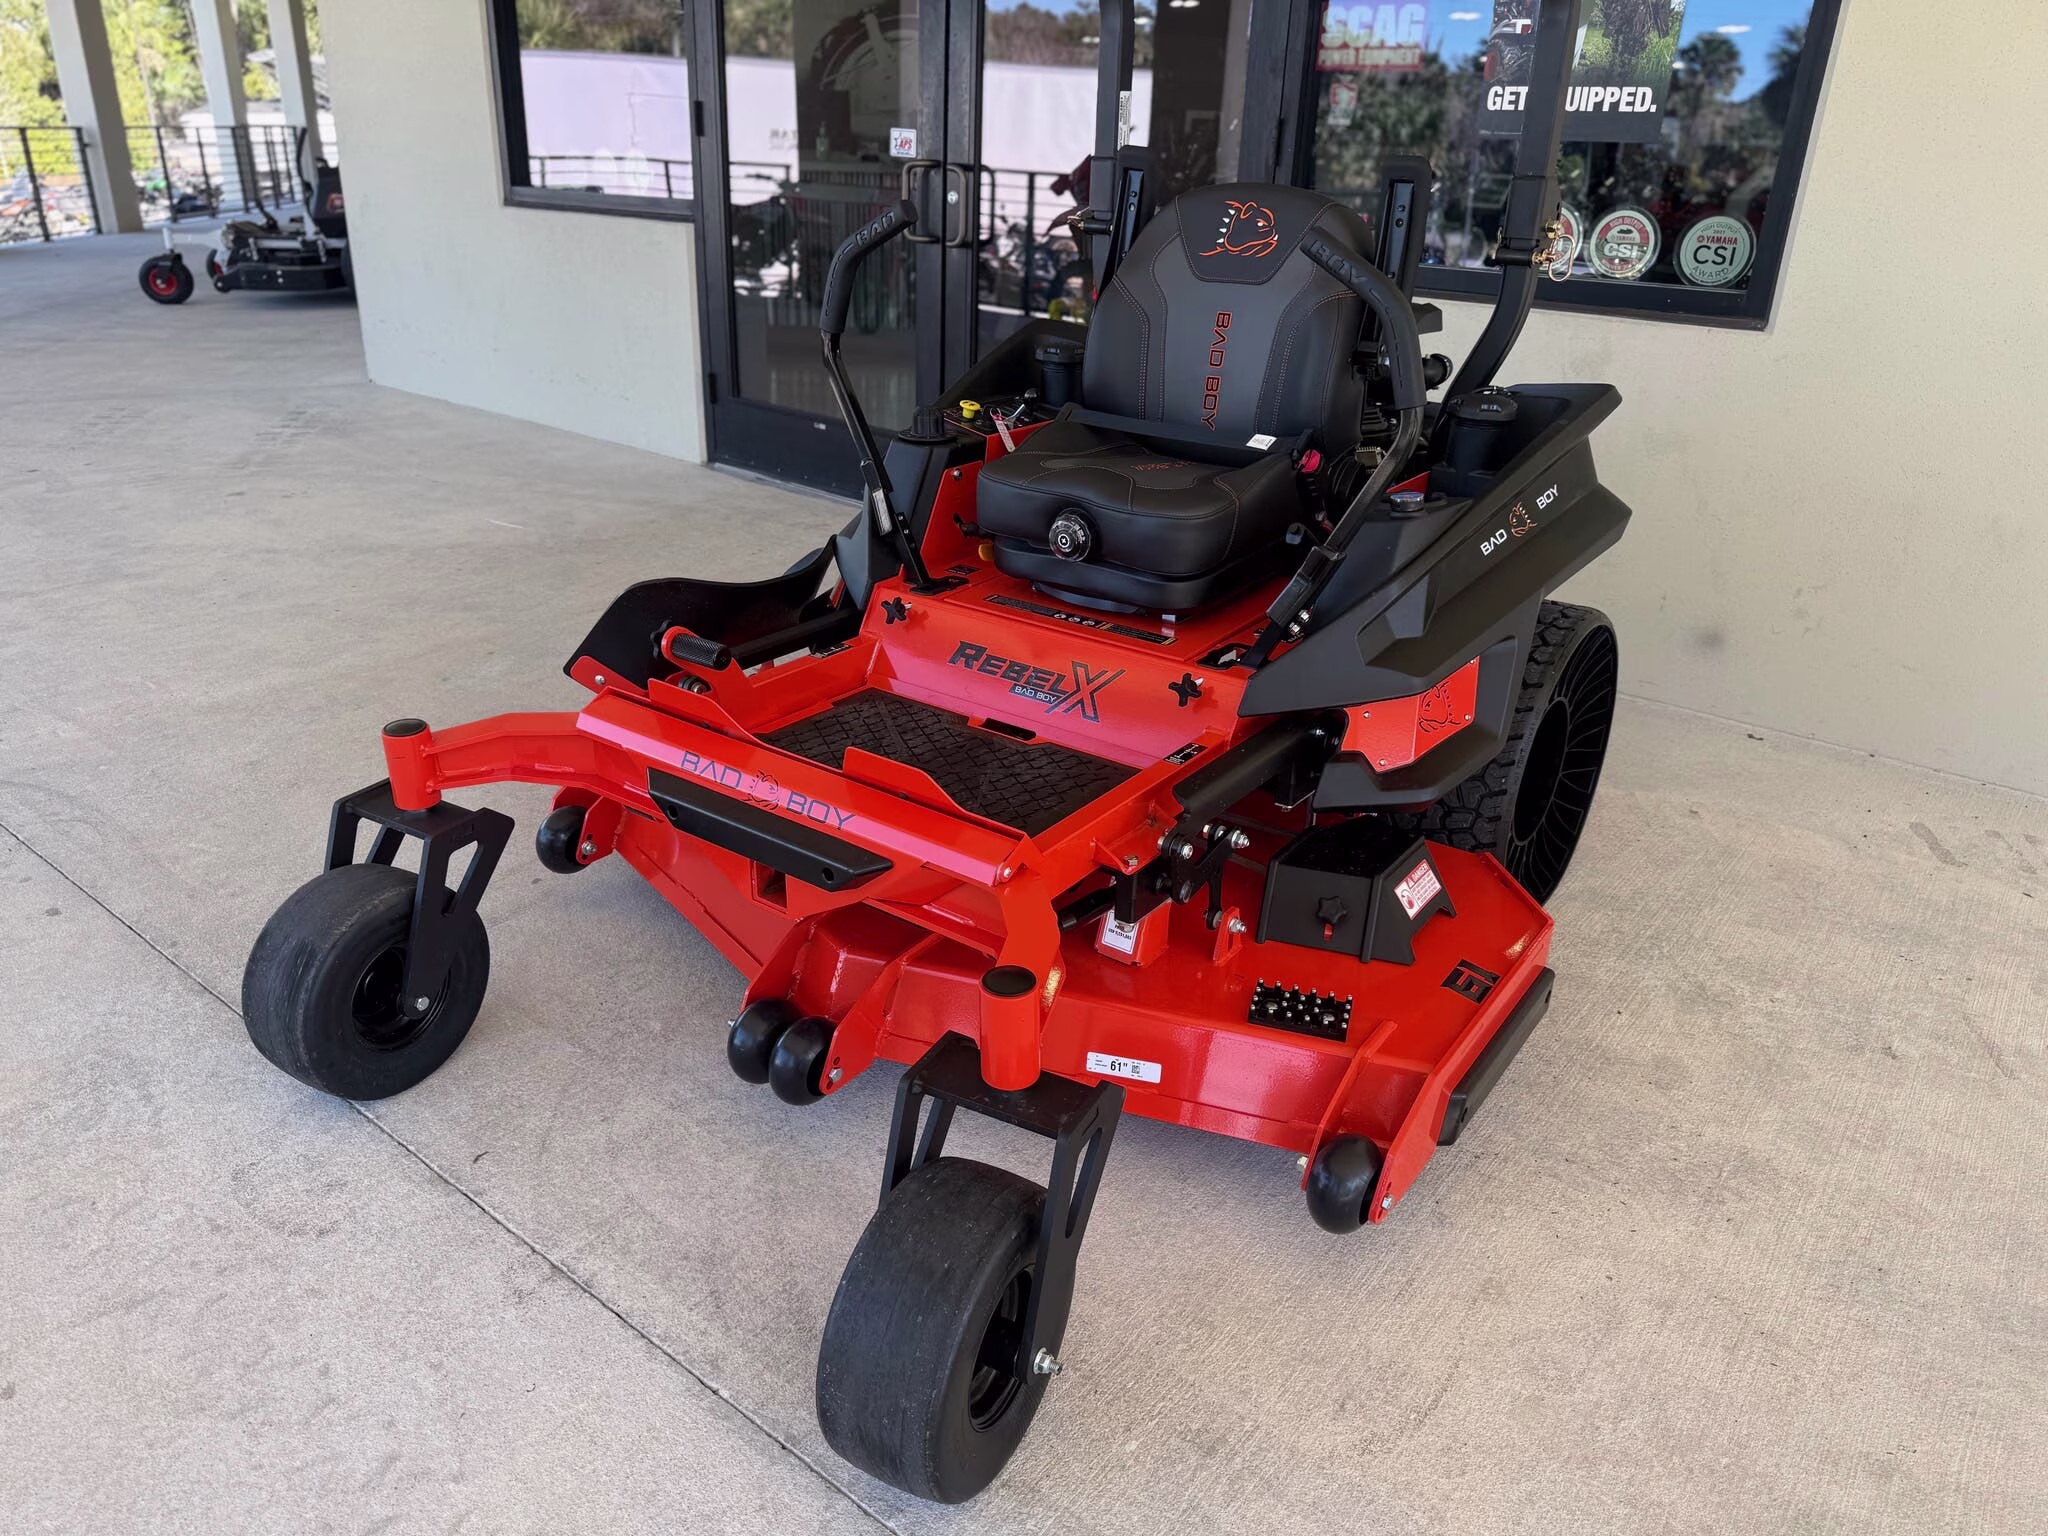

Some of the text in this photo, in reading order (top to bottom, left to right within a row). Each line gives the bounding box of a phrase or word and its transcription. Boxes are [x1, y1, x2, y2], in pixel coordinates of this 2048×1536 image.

[1321, 4, 1426, 48] SCAG
[1487, 86, 1657, 112] GET UIPPED.
[1603, 242, 1639, 259] CSI
[1706, 235, 1738, 246] YAMAHA
[1693, 245, 1737, 266] CSI
[1692, 265, 1729, 278] AWARD
[1201, 310, 1233, 432] BAD BOY
[1480, 484, 1559, 556] BAD BOY
[1014, 685, 1057, 703] BAD BOY
[680, 751, 856, 830] BAD BOY
